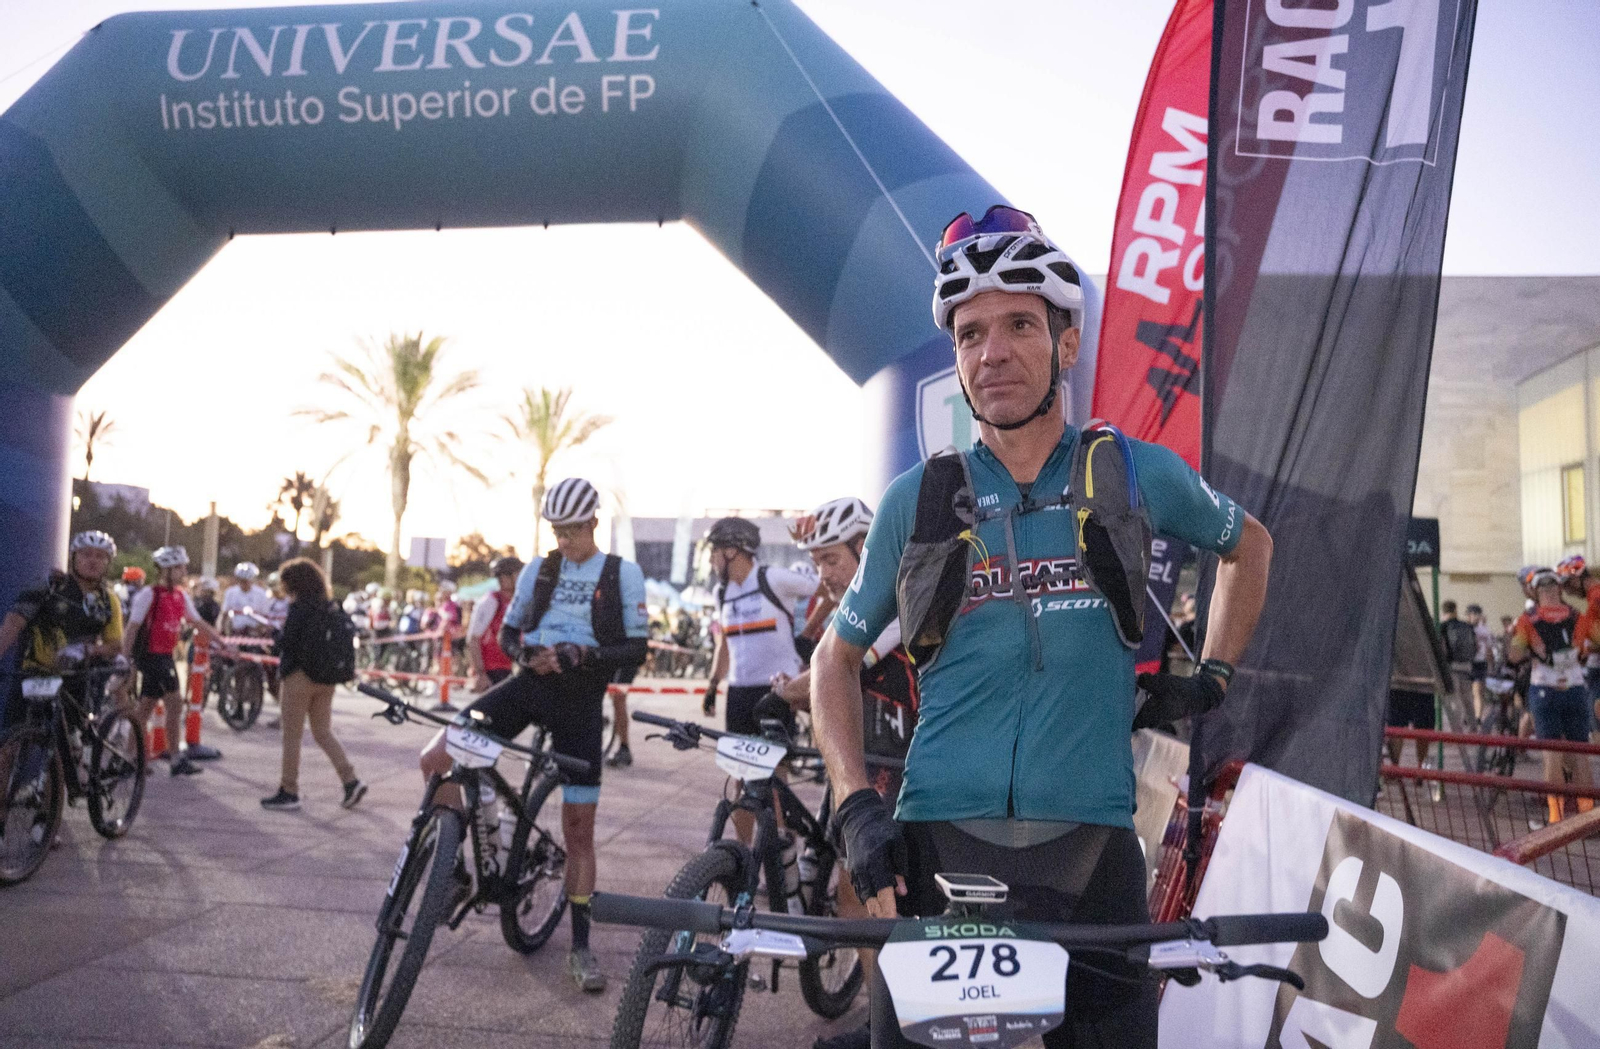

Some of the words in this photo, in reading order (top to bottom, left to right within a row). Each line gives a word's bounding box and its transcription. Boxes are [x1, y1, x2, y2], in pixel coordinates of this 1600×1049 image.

[167, 8, 660, 81] UNIVERSAE
[161, 90, 324, 130] Instituto
[338, 80, 518, 131] Superior
[530, 77, 586, 116] de
[601, 74, 656, 113] FP
[1115, 106, 1208, 304] RPM
[732, 740, 770, 756] 260
[928, 942, 1021, 983] 278
[958, 984, 1001, 1001] JOEL
